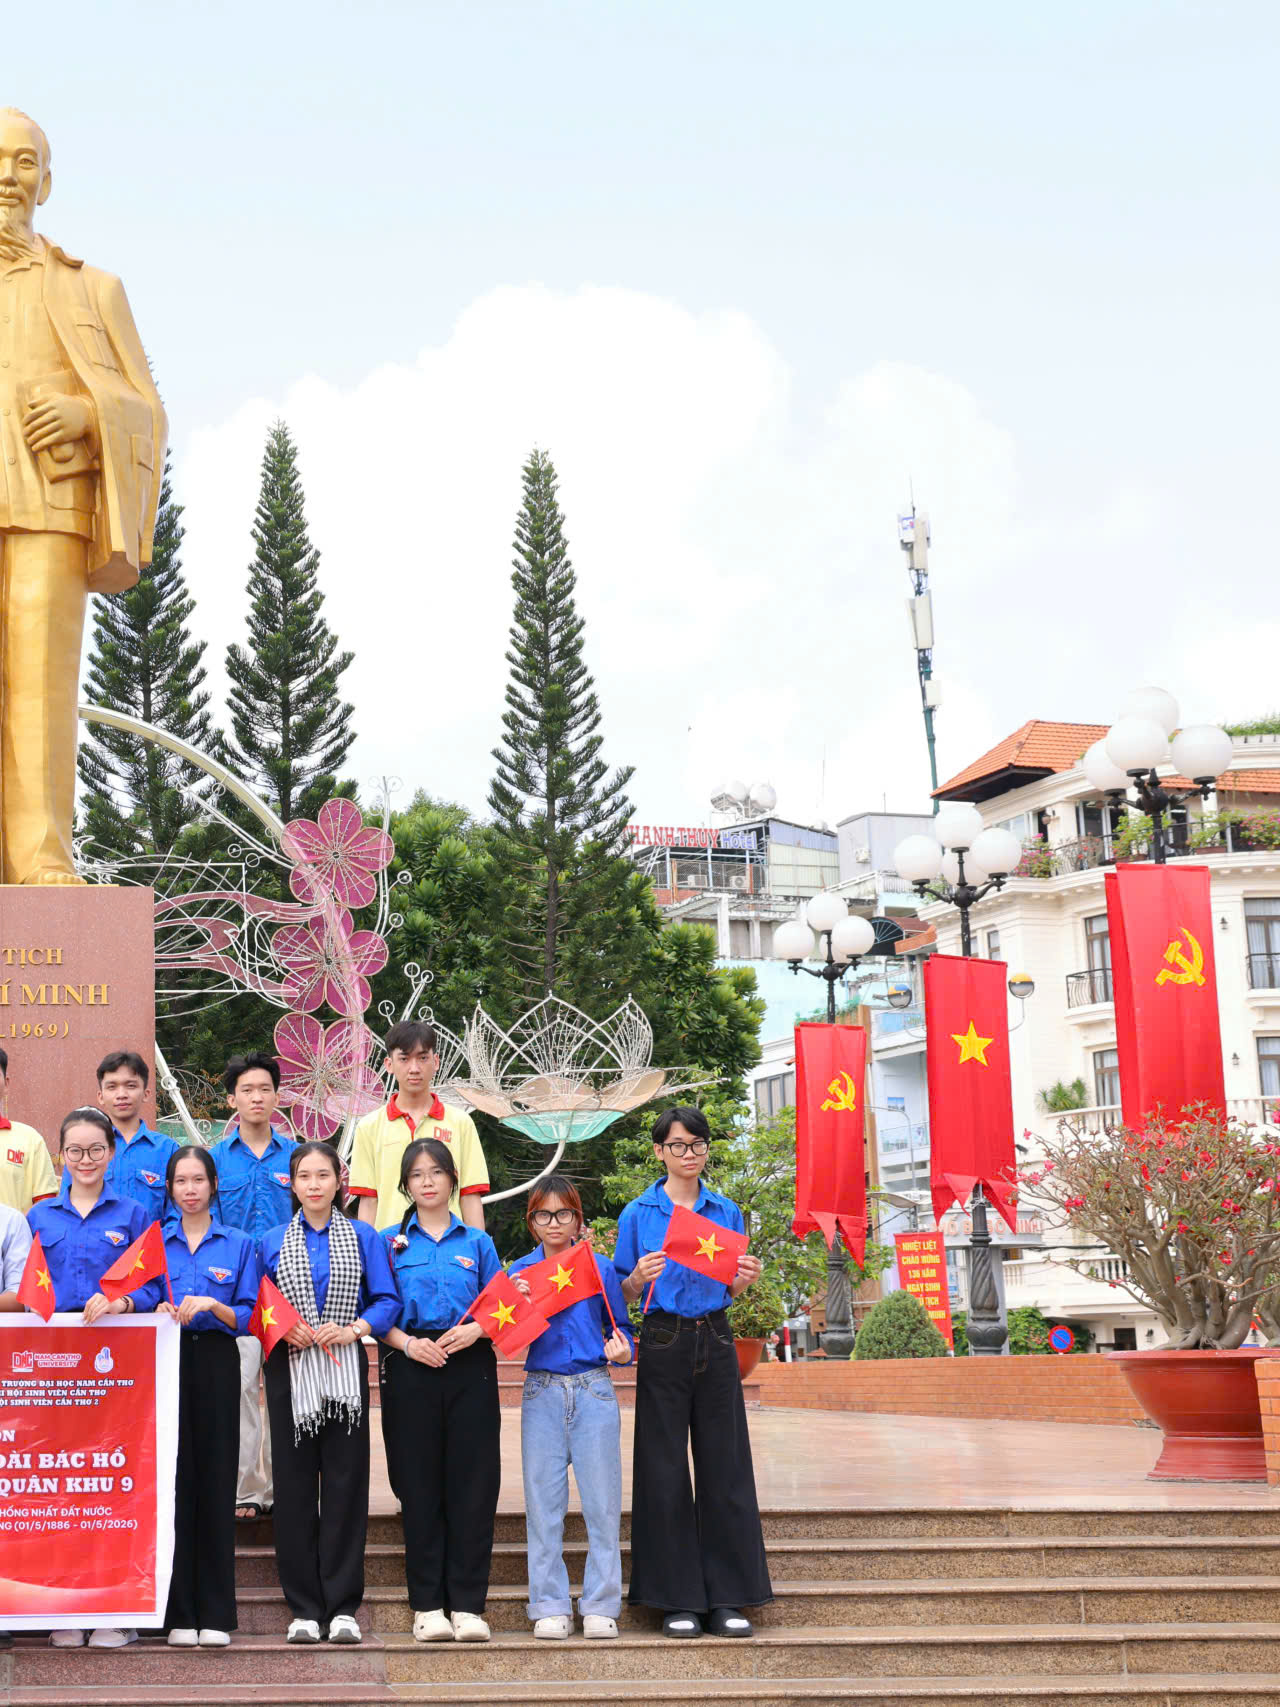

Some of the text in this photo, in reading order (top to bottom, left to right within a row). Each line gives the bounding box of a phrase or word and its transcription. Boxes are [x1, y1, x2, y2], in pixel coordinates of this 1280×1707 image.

[3, 948, 63, 969] TỊCH
[20, 983, 110, 1006] MINH
[39, 1380, 54, 1388] ĐẠI
[57, 1380, 74, 1388] HỌC
[7, 1389, 23, 1398] HỘI
[48, 1388, 67, 1396] VIÊN
[32, 1398, 53, 1406] VIÊN
[38, 1450, 85, 1468] BÁC
[93, 1446, 126, 1468] HỒ
[66, 1477, 114, 1493] KHU
[122, 1477, 133, 1492] 9
[31, 1506, 58, 1517] NHẤT
[60, 1506, 80, 1516] ĐẤT
[83, 1505, 112, 1516] NƯỚC
[14, 1521, 70, 1531] (01/5/1886
[80, 1519, 138, 1531] 01/5/2026)
